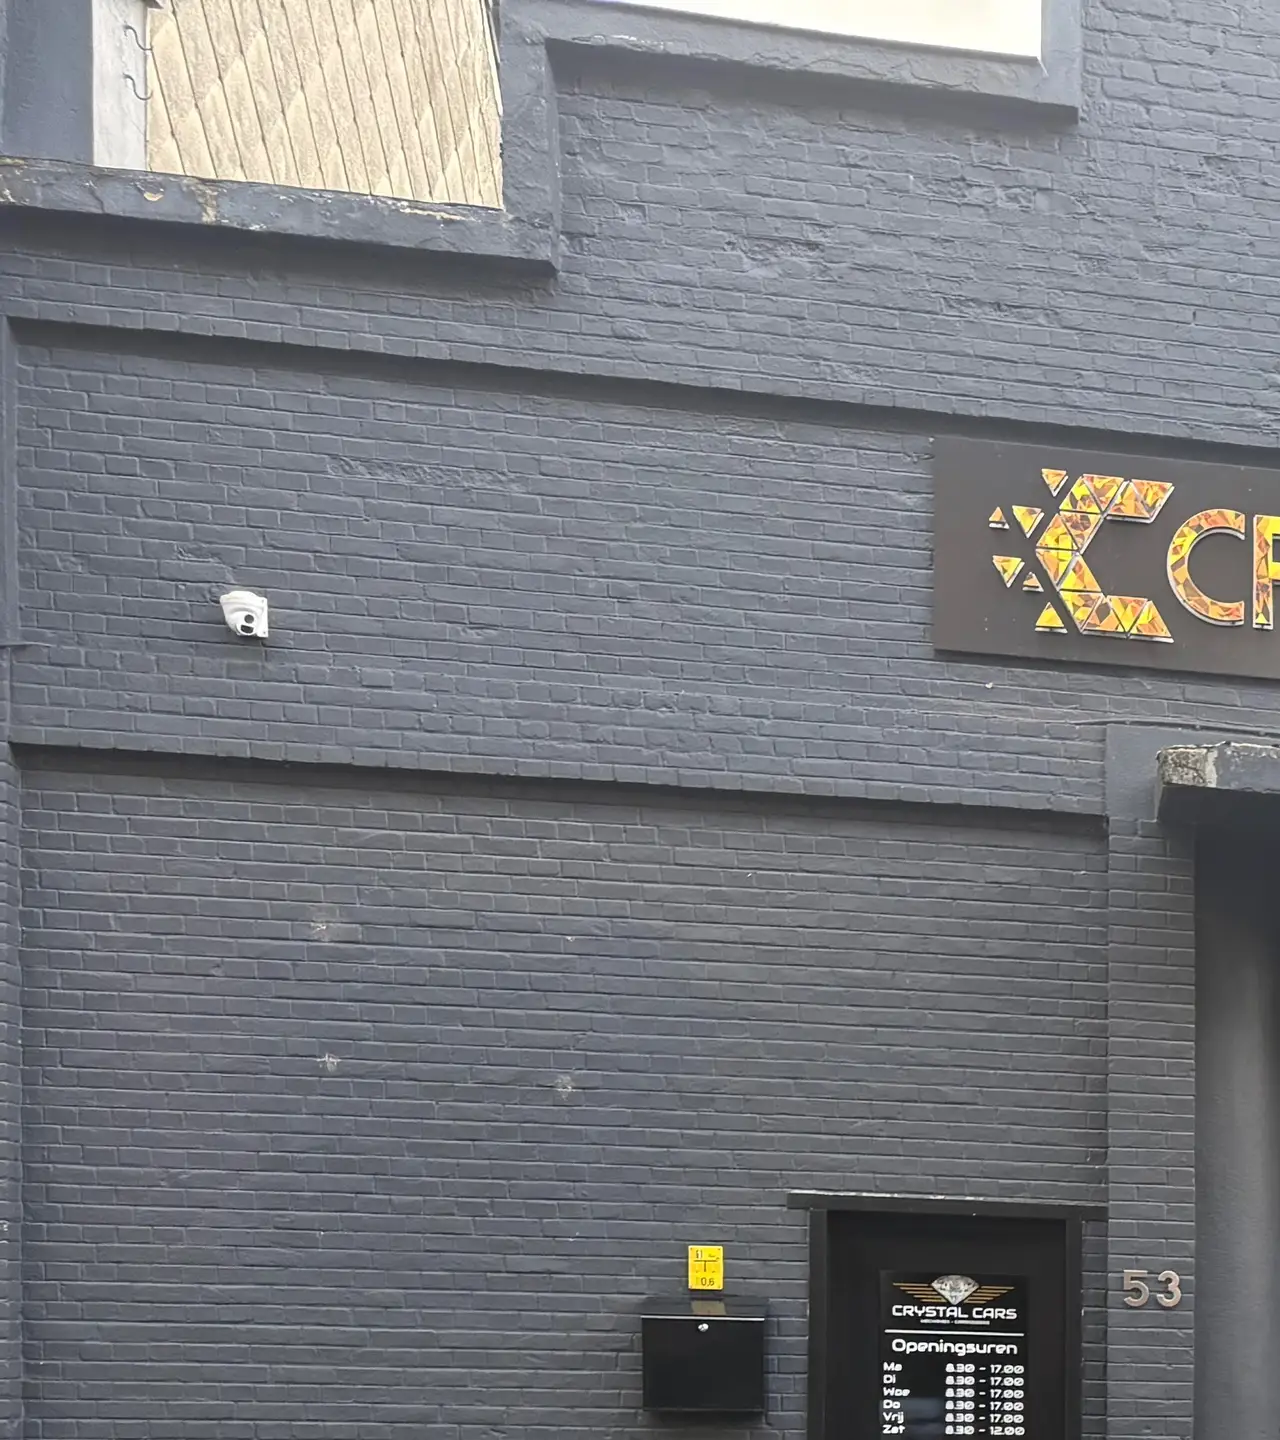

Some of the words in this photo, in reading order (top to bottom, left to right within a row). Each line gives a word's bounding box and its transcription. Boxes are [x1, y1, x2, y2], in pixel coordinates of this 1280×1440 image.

[1123, 1269, 1182, 1308] 53
[892, 1305, 968, 1318] CRYSTAL
[973, 1308, 1017, 1319] CARS
[892, 1339, 1017, 1356] Openingsuren
[884, 1374, 896, 1383] Di
[883, 1387, 910, 1396] Woe
[883, 1400, 900, 1408] Do
[883, 1412, 903, 1423] Vrij
